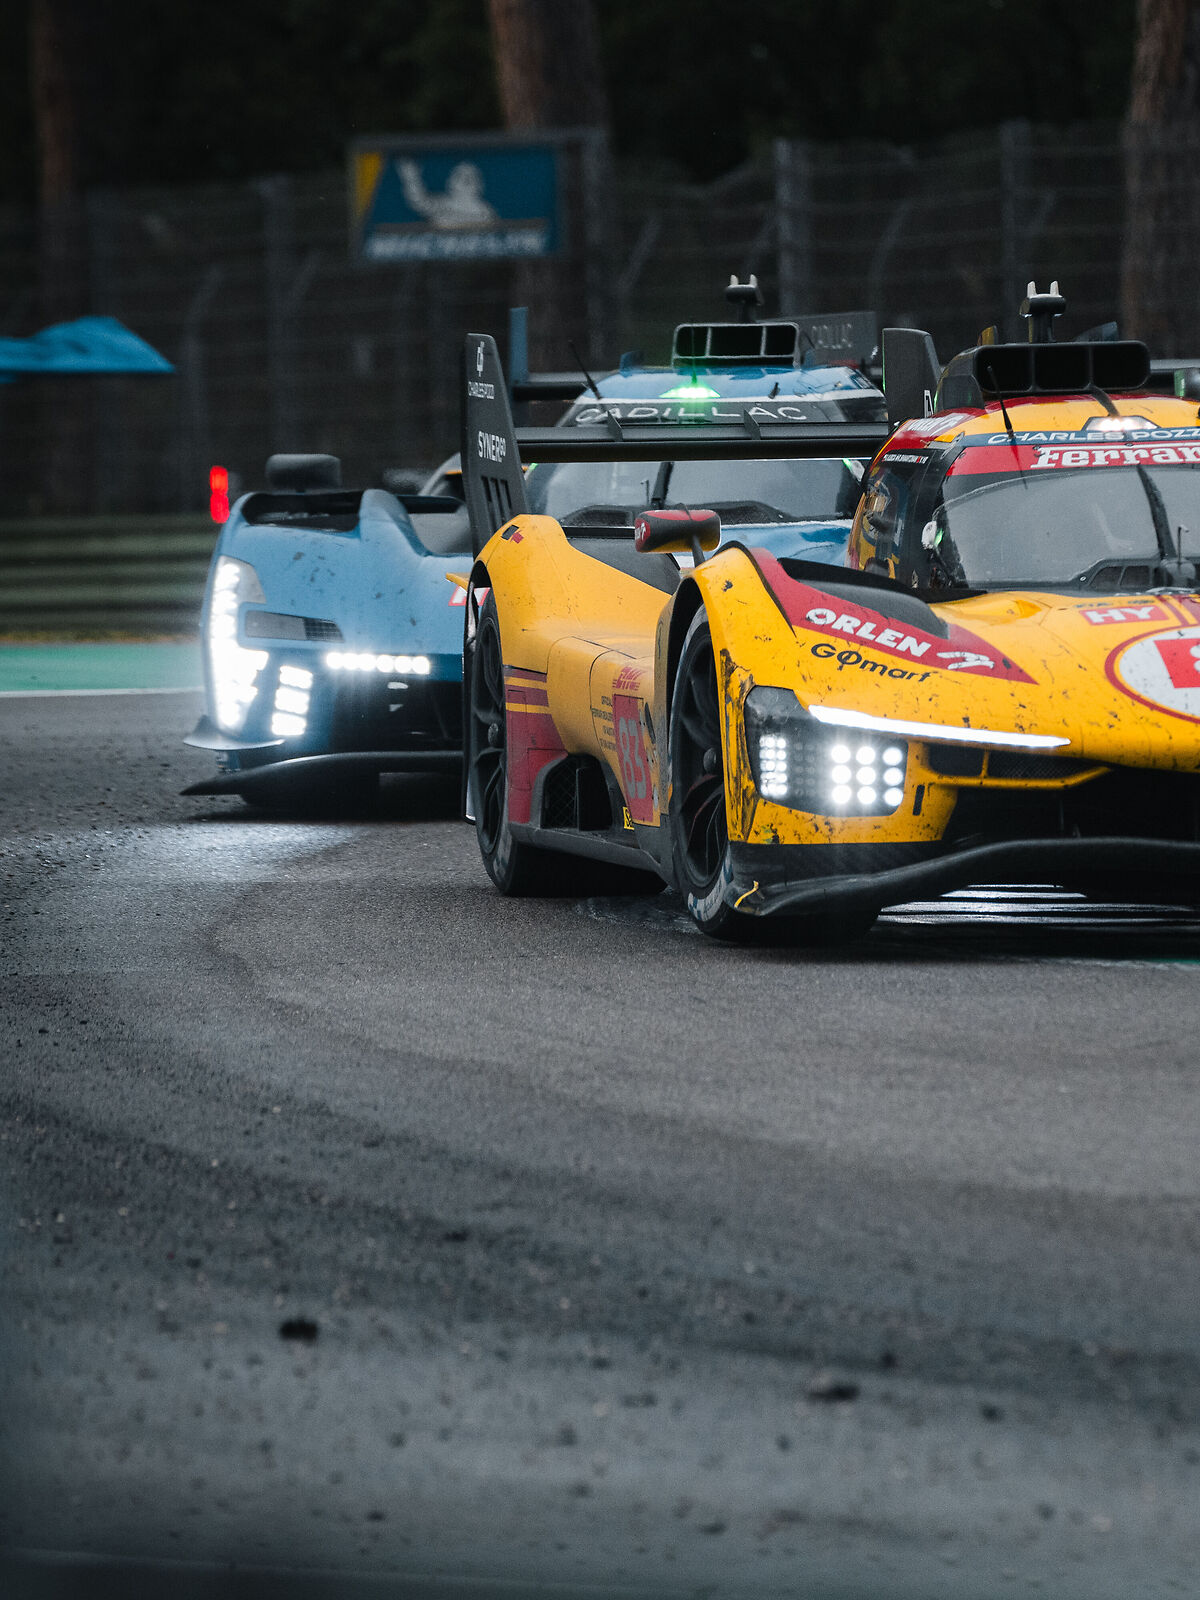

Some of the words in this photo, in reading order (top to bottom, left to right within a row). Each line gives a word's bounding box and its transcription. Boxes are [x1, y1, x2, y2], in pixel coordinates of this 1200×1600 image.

[575, 405, 807, 424] CADILLAC
[987, 430, 1125, 444] CHARLES
[1085, 604, 1158, 624] HY
[805, 608, 932, 658] ORLEN
[618, 716, 647, 799] 83
